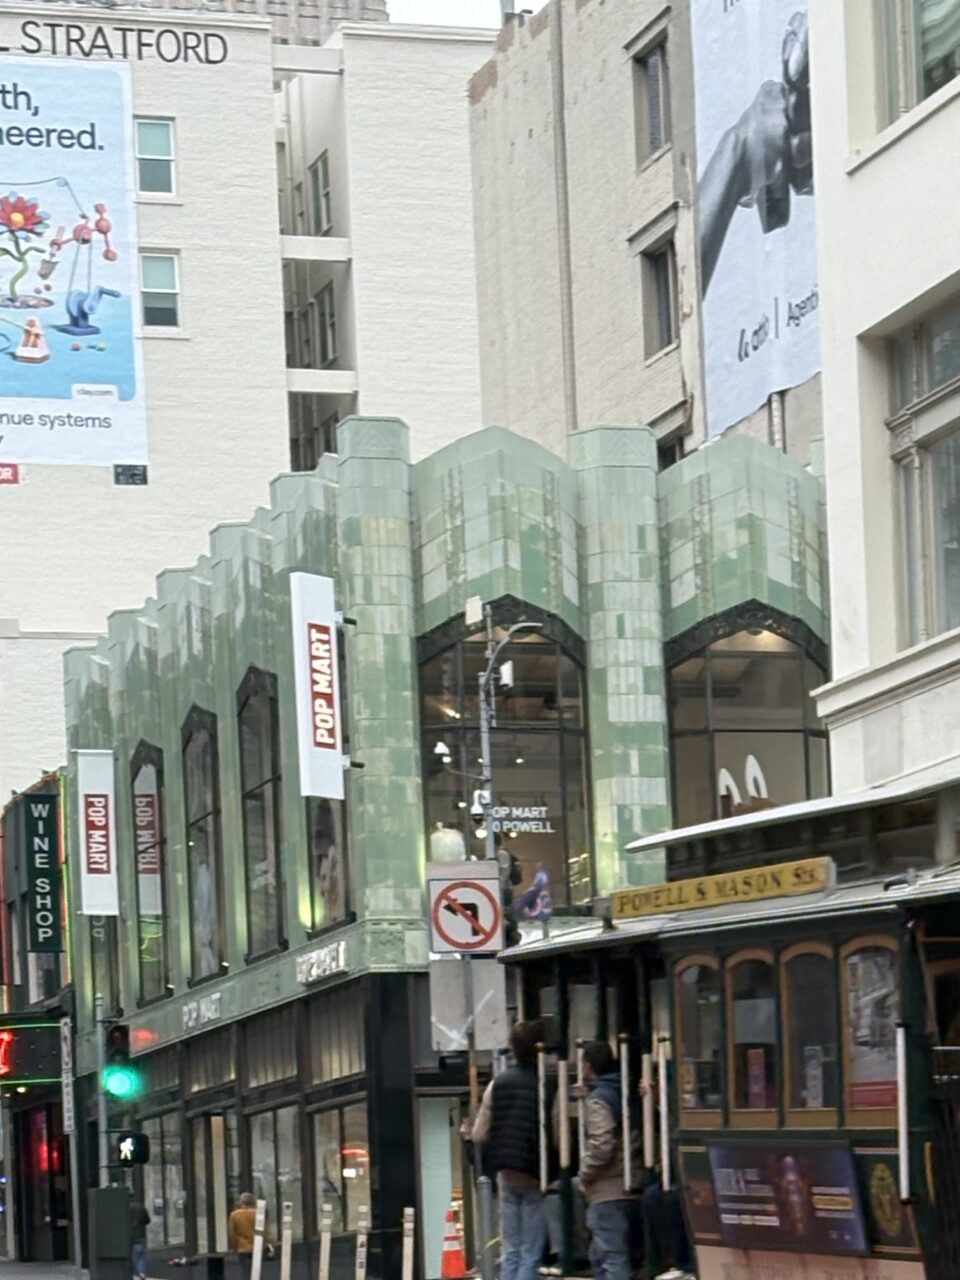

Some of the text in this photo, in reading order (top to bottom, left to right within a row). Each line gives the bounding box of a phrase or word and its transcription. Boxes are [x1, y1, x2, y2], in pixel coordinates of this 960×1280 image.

[20, 20, 228, 64] STRATFORD
[0, 122, 104, 150] eered.
[38, 413, 112, 430] systems
[310, 628, 336, 745] POP MART
[87, 797, 108, 871] POP MART
[503, 821, 556, 833] POWELL
[511, 806, 548, 818] MART
[30, 803, 53, 942] WINE SHOP
[618, 886, 684, 913] POWELL
[715, 869, 784, 897] MASON
